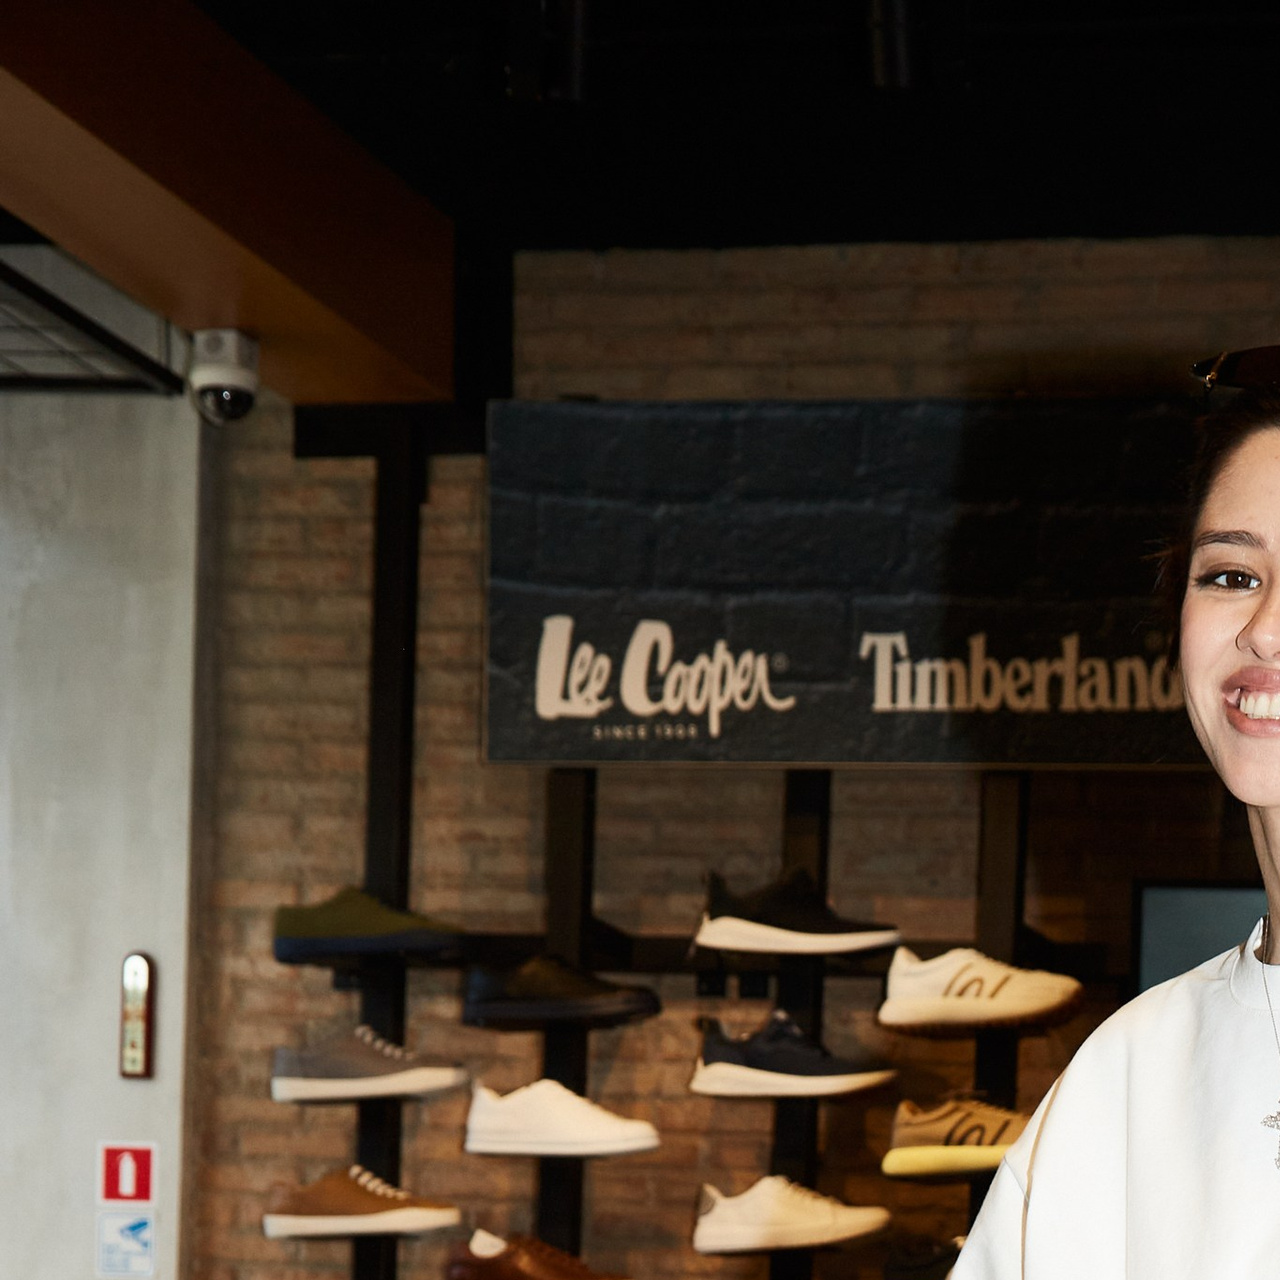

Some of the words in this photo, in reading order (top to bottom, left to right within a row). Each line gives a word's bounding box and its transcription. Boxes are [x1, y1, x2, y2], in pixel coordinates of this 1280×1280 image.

[535, 613, 613, 720] Lee
[619, 618, 796, 739] Cooper
[593, 724, 648, 740] SINCE
